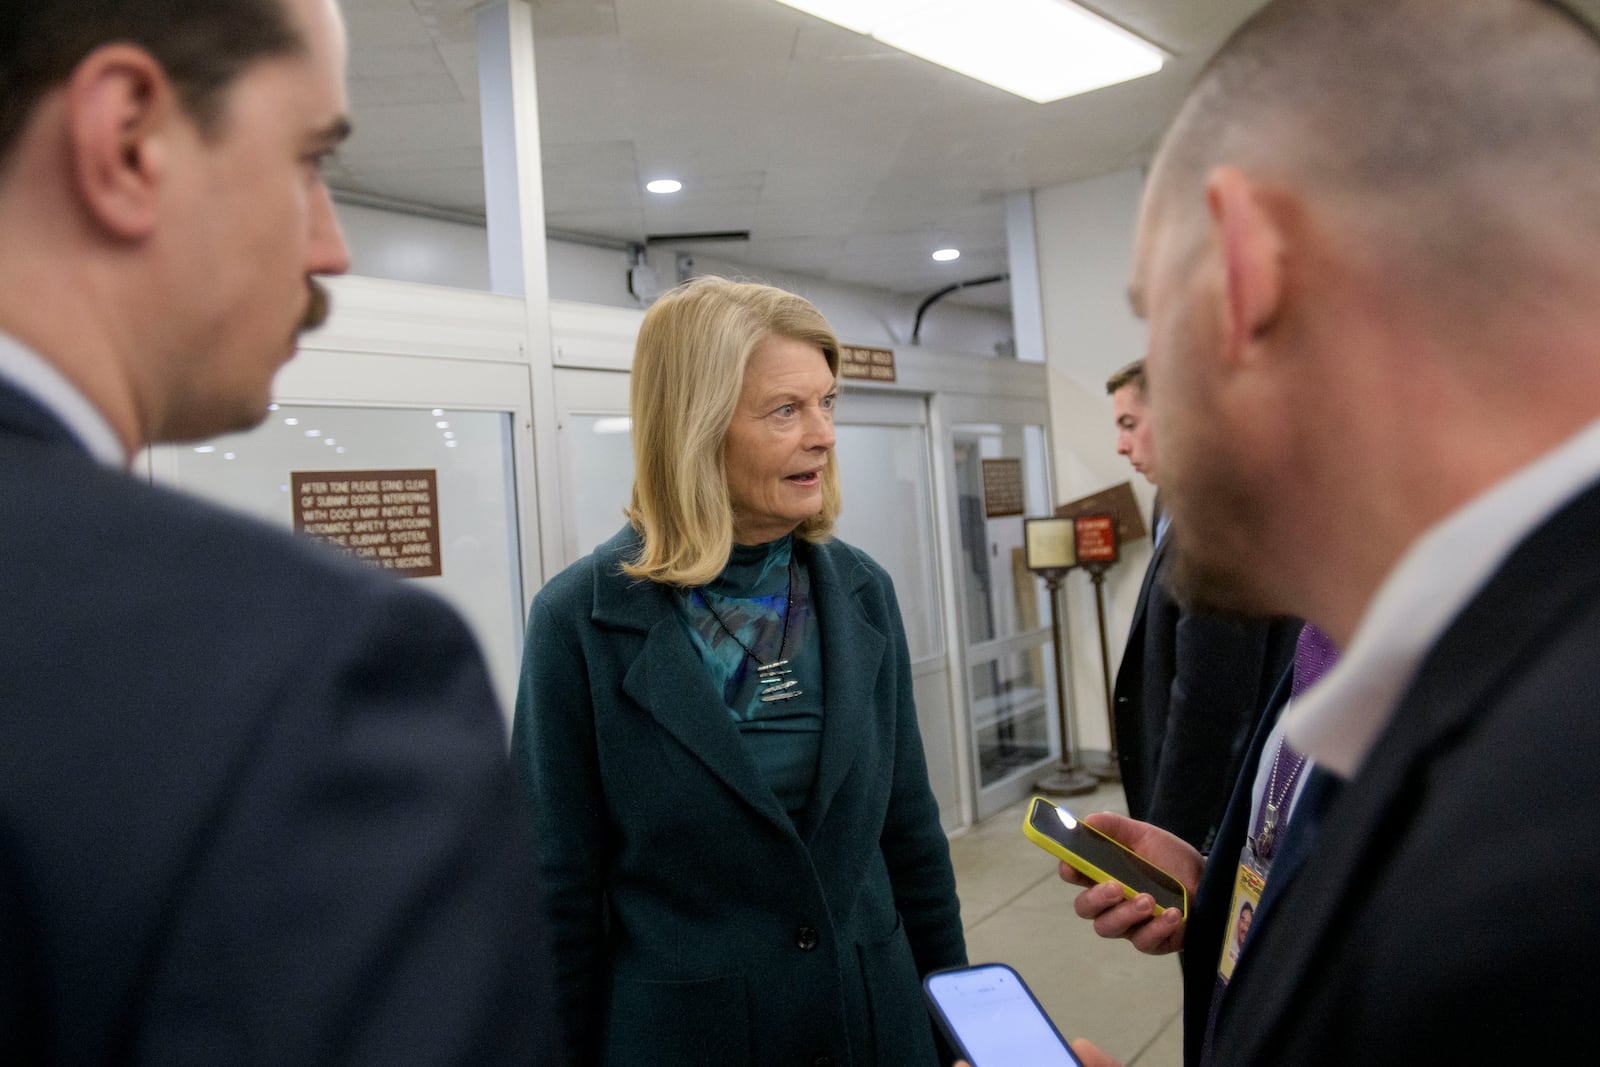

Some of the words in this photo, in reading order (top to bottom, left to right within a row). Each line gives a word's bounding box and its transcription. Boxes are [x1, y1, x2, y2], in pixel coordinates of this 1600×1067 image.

[301, 482, 328, 494] AFTER
[329, 481, 350, 494] TONE
[351, 480, 379, 493] PLEASE
[380, 479, 404, 492] STAND
[405, 479, 429, 490] CLEAR
[301, 496, 314, 508] OF
[316, 495, 349, 507] SUBWAY
[382, 492, 430, 505] INTERFERING
[302, 510, 328, 521] WITH
[329, 508, 358, 520] DOOR
[360, 507, 379, 518] MAY
[382, 505, 414, 518] INITIATE
[416, 505, 430, 515] AN
[304, 521, 351, 534] AUTOMATIC
[353, 519, 385, 532] SAFETY
[387, 518, 432, 531] SHUTDOWN
[350, 532, 387, 546] SUBWAY
[356, 546, 376, 558] CAR
[378, 545, 400, 557] WILL
[402, 543, 432, 555] ARRIVE
